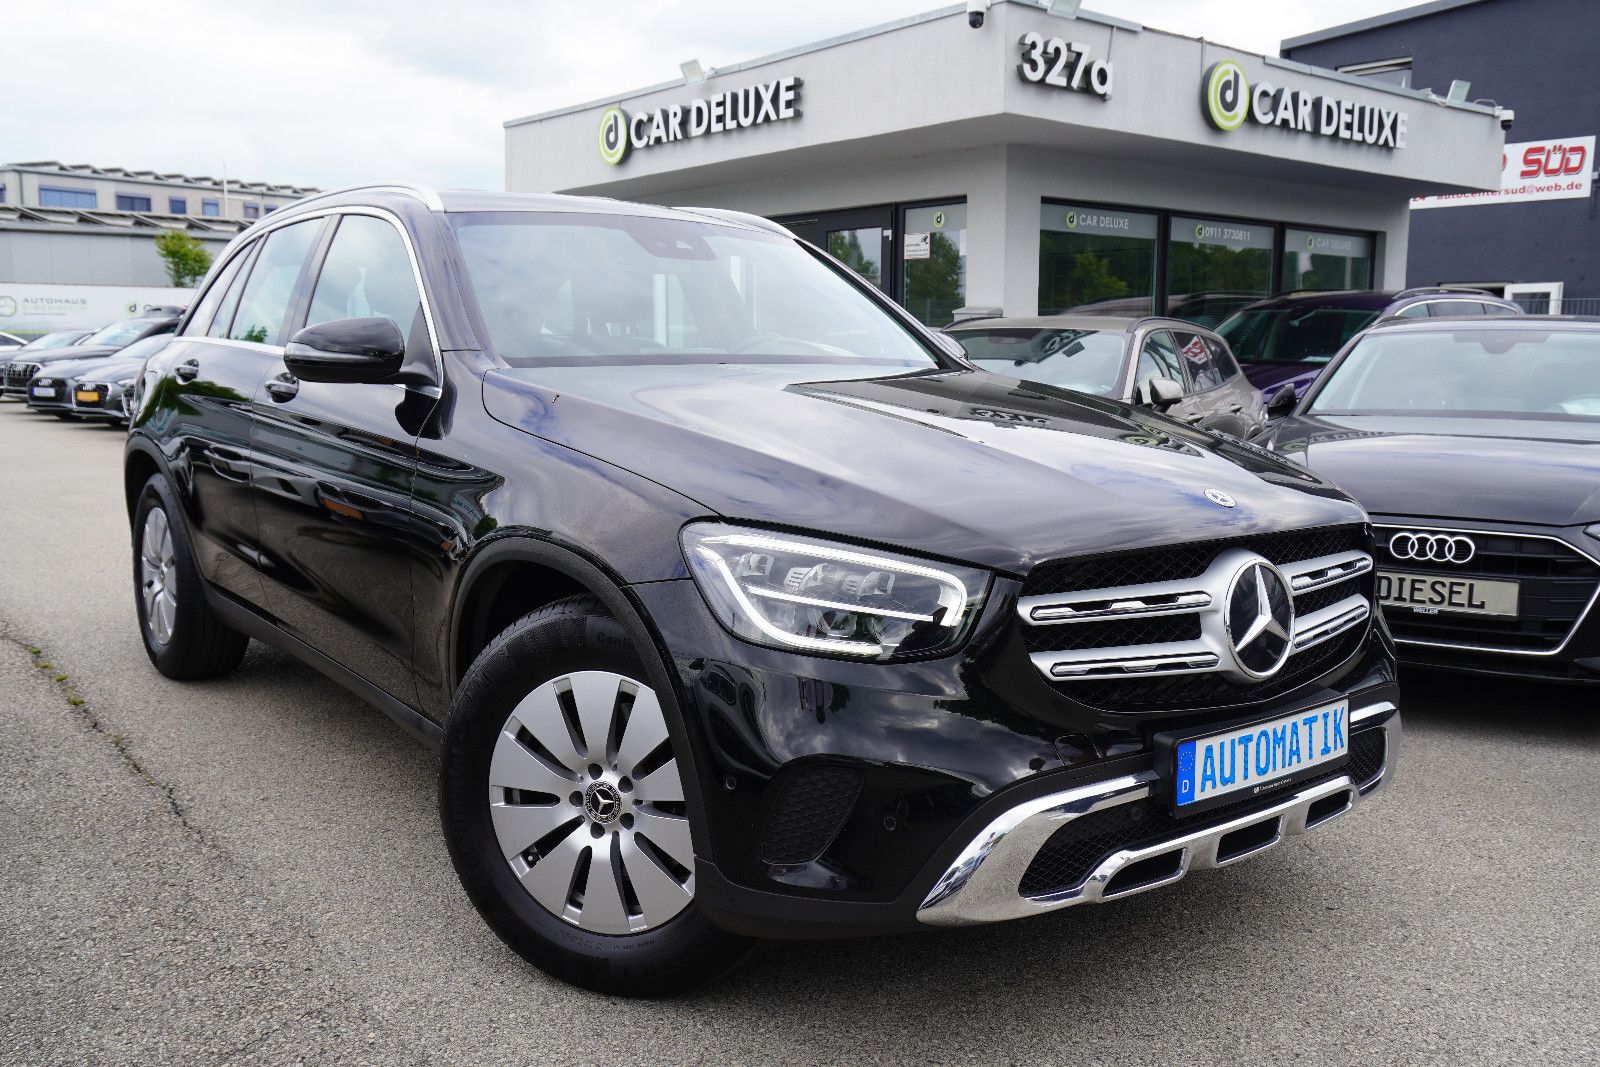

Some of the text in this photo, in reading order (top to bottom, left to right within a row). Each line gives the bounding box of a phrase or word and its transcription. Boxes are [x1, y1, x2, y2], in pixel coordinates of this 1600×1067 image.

[1019, 31, 1114, 96] 327a
[629, 104, 683, 149] CAR
[691, 76, 797, 138] DELUXE
[1252, 80, 1313, 132] CAR
[1320, 95, 1409, 149] DELUXE
[1519, 144, 1588, 180] SÜD
[1079, 213, 1098, 227] CAR
[1100, 216, 1129, 230] DELUXE
[1205, 225, 1221, 238] 0911
[1316, 237, 1330, 249] CAR
[22, 297, 87, 305] AUTOHAUS
[1377, 575, 1486, 610] DIESEL
[1413, 607, 1439, 615] WELLER
[1181, 706, 1345, 794] D AUTOMATIK
